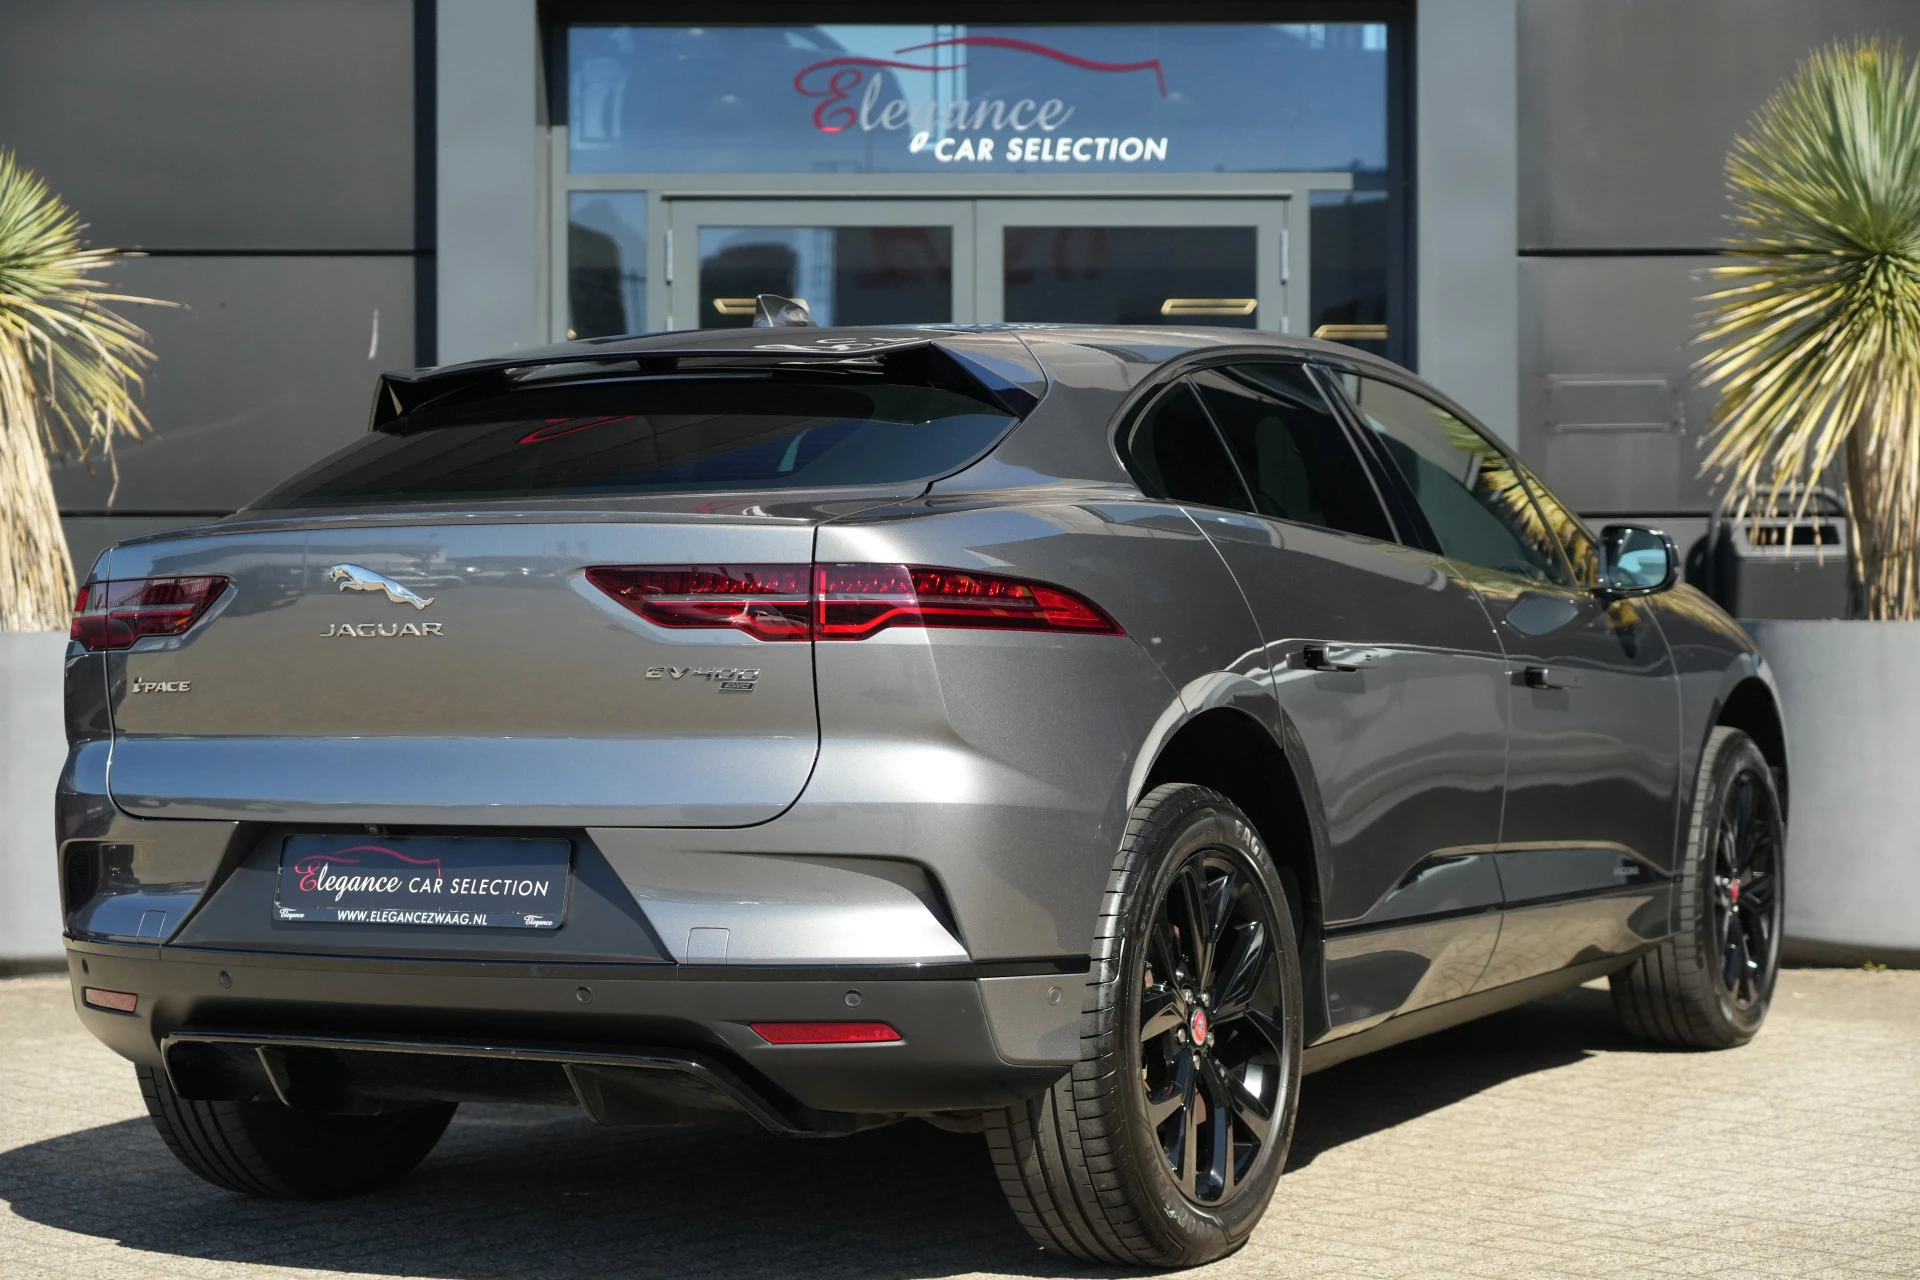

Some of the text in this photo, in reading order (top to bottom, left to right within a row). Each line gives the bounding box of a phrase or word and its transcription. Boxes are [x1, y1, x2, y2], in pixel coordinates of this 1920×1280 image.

[794, 66, 1075, 152] Elegance
[934, 136, 1169, 162] CAR SELECTION
[319, 621, 445, 637] JAGUAR
[295, 860, 549, 901] Elegance CAR SELECTION
[279, 908, 305, 920] Elegance
[337, 910, 487, 926] WWW.ELEGANCEZWAAG.NL
[523, 914, 554, 928] Elegance
